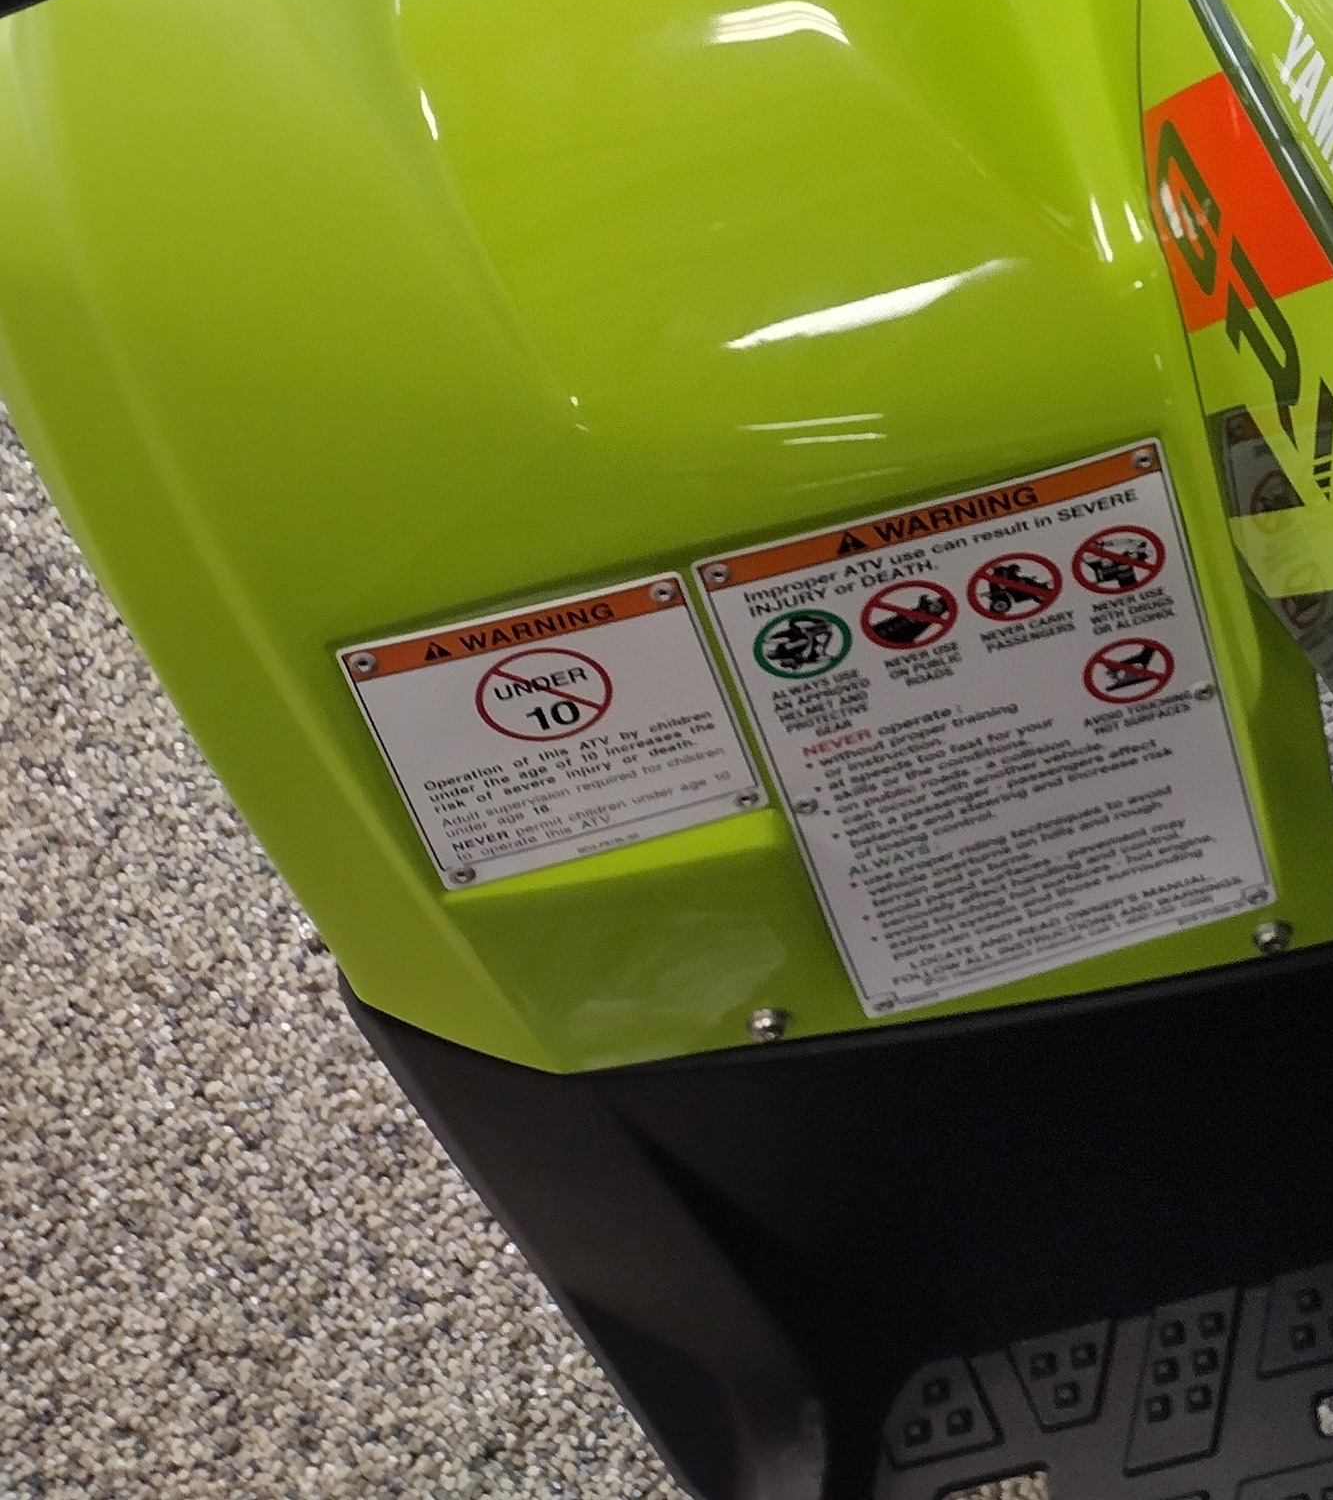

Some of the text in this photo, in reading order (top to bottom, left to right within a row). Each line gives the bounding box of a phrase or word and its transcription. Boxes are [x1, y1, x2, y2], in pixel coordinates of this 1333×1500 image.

[873, 484, 1038, 544] WARNING
[742, 488, 1138, 605] Improper ATV use can result in SEVERE
[747, 586, 829, 618] INJURY
[832, 579, 857, 595] or
[458, 602, 615, 651] WARNING
[980, 609, 1074, 642] NEVER CARRY
[985, 620, 1075, 653] PASSENGERS
[492, 666, 588, 701] UNDER
[524, 699, 583, 732] 10
[817, 702, 1019, 767] without proper training
[422, 709, 711, 792] Operation of this ATV by children
[428, 783, 476, 802] under
[483, 774, 511, 788] the
[517, 765, 549, 781] age
[554, 757, 574, 769] of
[605, 729, 682, 756] increases
[689, 721, 715, 734] the
[801, 729, 872, 756] NEVER
[433, 798, 466, 814] risk
[475, 791, 494, 803] of
[503, 776, 557, 796] severe
[565, 760, 613, 781] injury
[621, 754, 639, 764] or
[439, 745, 725, 828] Adult supervision required for children
[444, 820, 489, 839] under
[495, 811, 526, 827] age
[451, 830, 509, 853] NEVER
[514, 816, 563, 837] permit
[566, 798, 627, 821] children
[630, 786, 674, 804] under
[679, 777, 708, 792] age
[456, 851, 473, 862] to
[479, 834, 539, 858] operate
[543, 824, 572, 839] this
